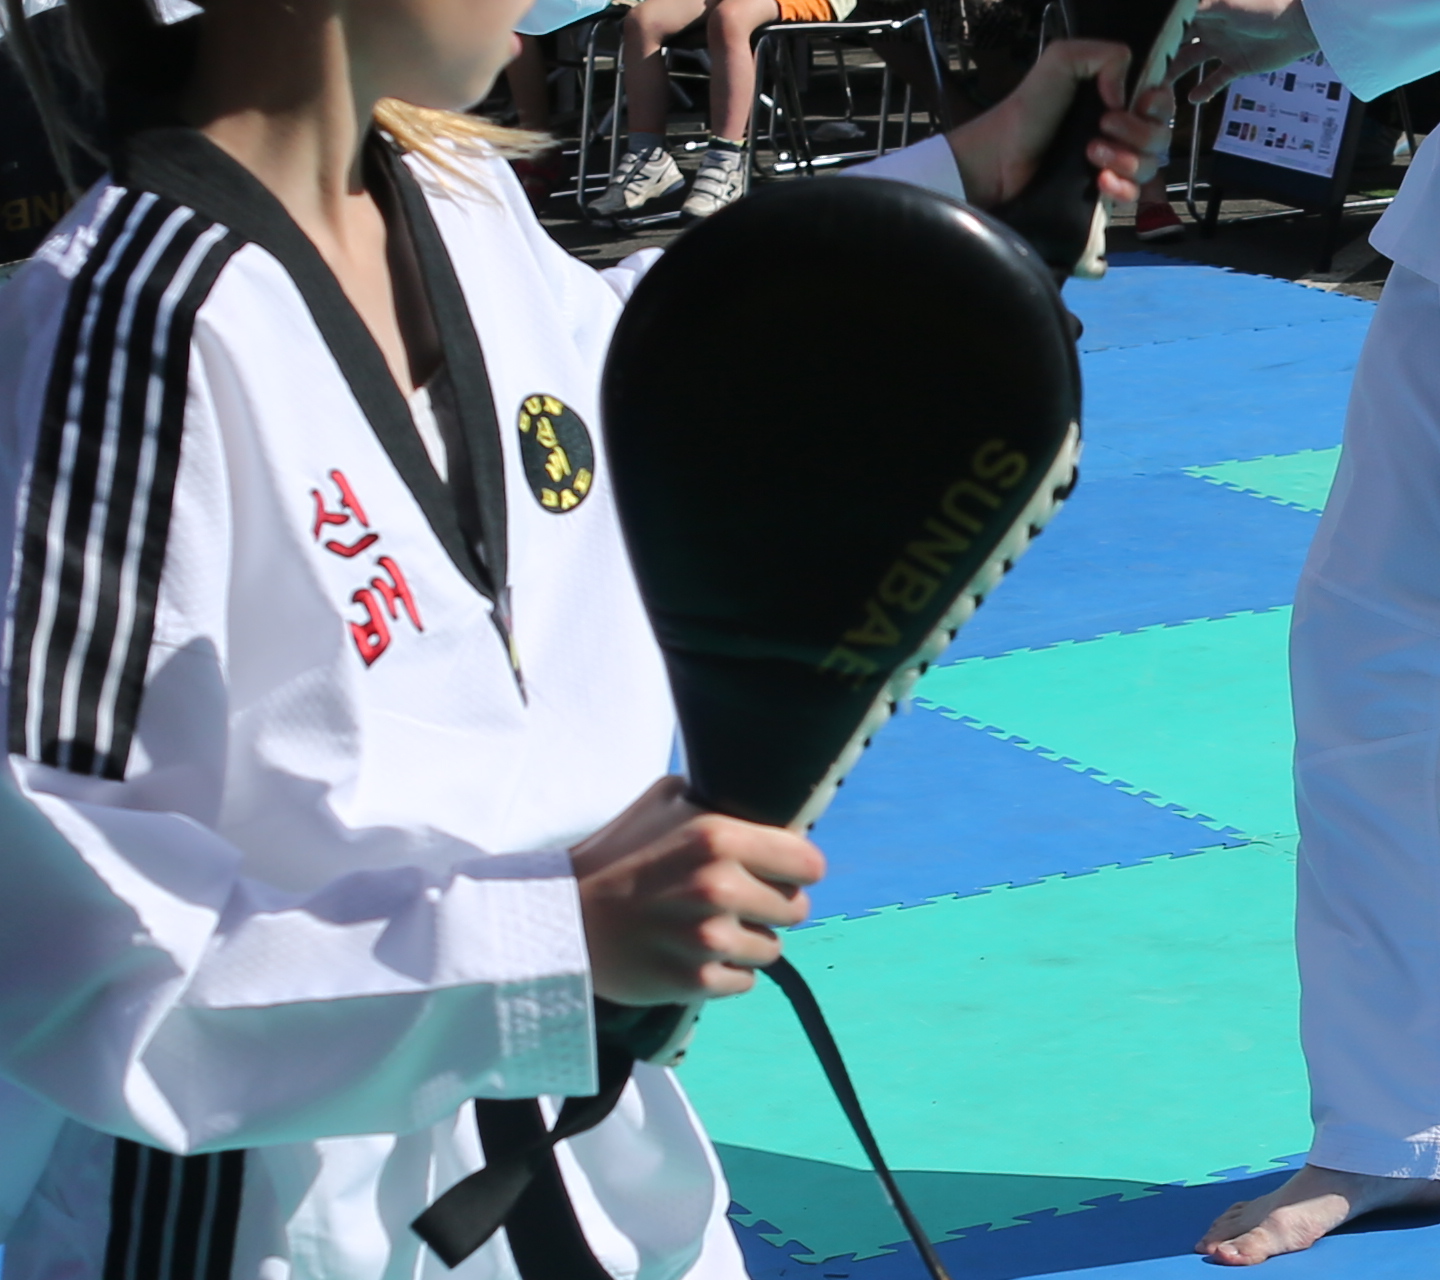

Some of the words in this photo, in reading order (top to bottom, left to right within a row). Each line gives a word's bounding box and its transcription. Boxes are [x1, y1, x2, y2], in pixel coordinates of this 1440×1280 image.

[518, 395, 564, 433] SUN
[310, 468, 425, 669] 선배
[817, 437, 1029, 692] SUNBAE
